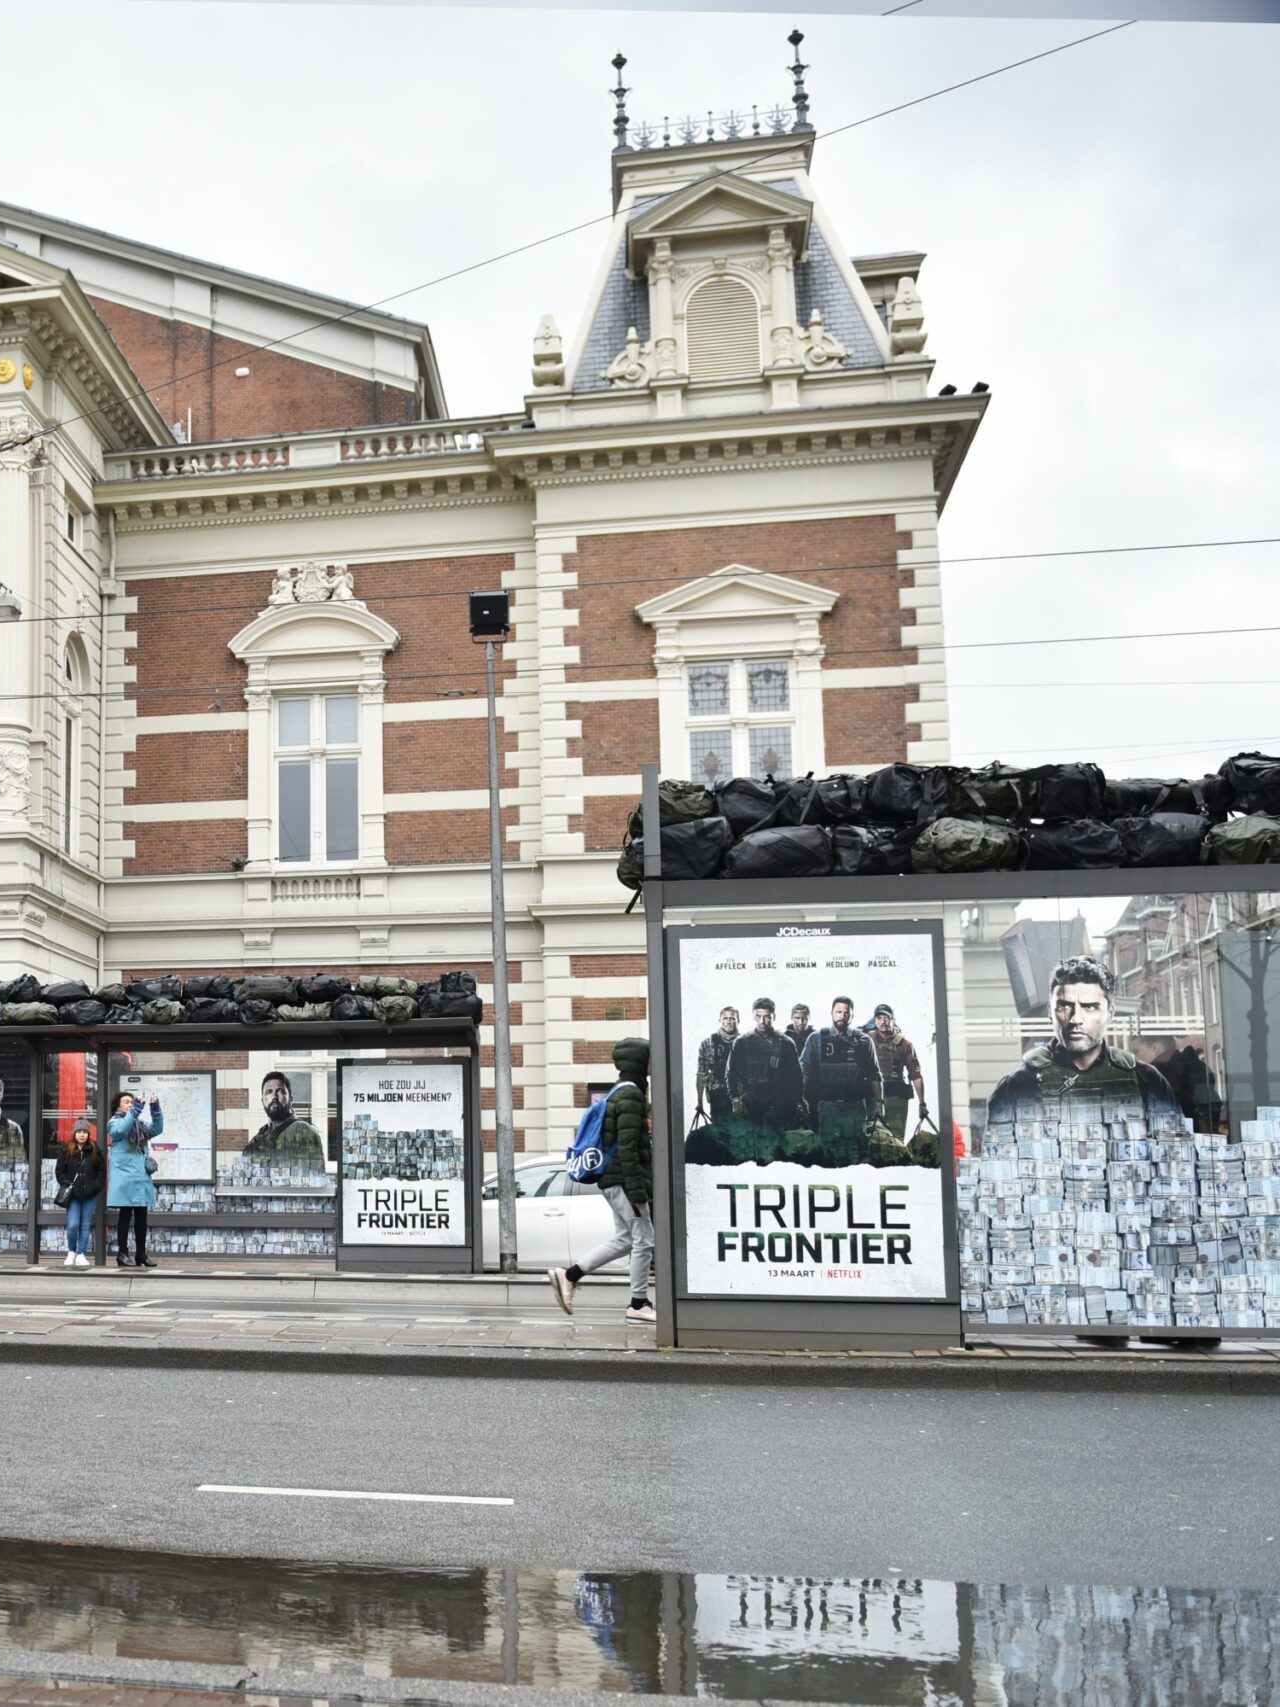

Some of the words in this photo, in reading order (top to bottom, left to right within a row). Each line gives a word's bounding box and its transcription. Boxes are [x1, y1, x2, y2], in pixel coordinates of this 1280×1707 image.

[776, 926, 831, 937] JCDecaux
[715, 962, 746, 970] AFFLECK
[754, 961, 777, 969] ISAAC
[786, 961, 817, 969] HUNNAM
[826, 960, 860, 968] HEDLUND
[868, 960, 897, 968] PASCAL
[378, 1080, 394, 1090] HOE
[396, 1080, 411, 1090] ZOU
[353, 1093, 365, 1103] 75
[367, 1093, 403, 1102] MILJOEN
[405, 1092, 452, 1102] MEENEMEN?
[357, 1188, 450, 1211] TRIPLE
[716, 1183, 911, 1230] TRIPLE
[357, 1213, 450, 1229] FRONTIER
[717, 1231, 913, 1265] FRONTIER
[768, 1269, 779, 1277] 13
[780, 1270, 816, 1278] MAART
[827, 1269, 862, 1279] NETFLIX
